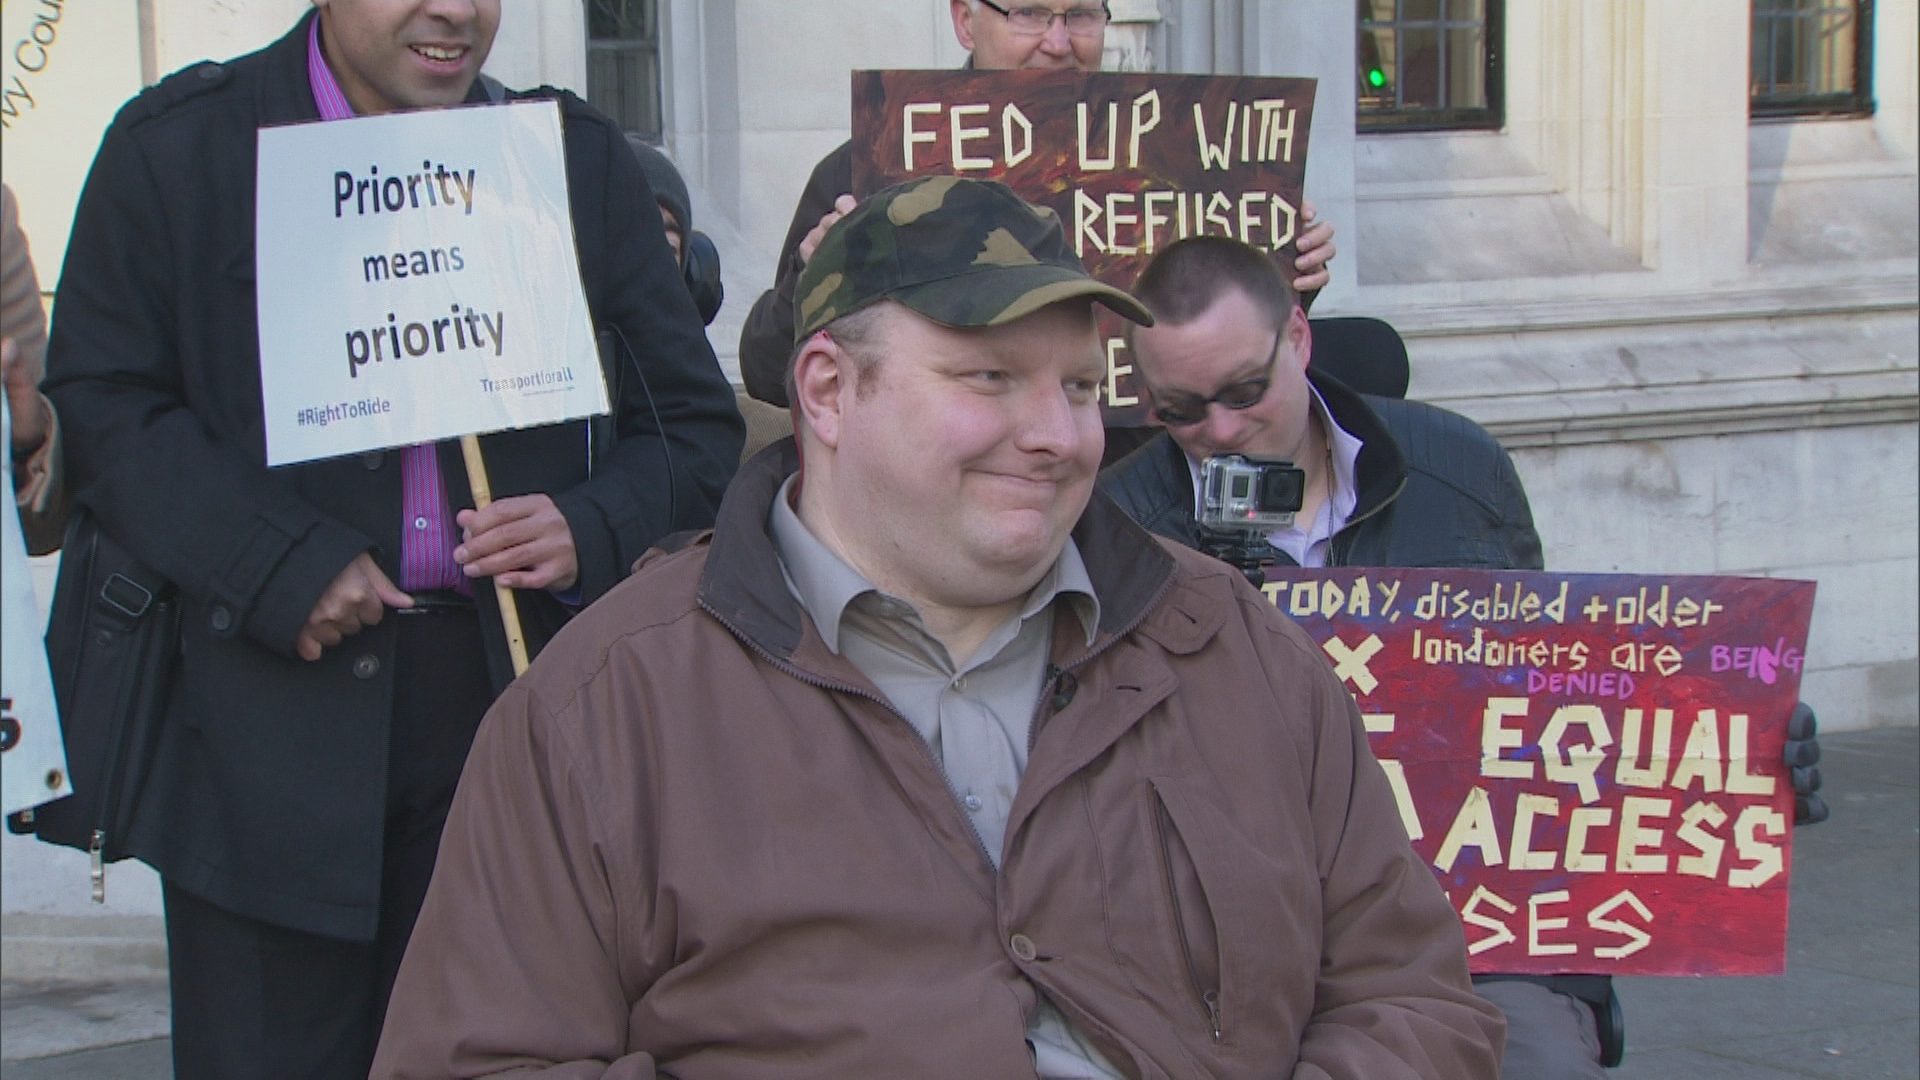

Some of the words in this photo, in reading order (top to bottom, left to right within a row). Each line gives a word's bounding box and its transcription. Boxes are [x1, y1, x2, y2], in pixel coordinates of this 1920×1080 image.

[903, 102, 1033, 171] FED
[1076, 89, 1161, 171] UP
[1193, 98, 1297, 171] WITH
[334, 160, 475, 218] Priority
[1074, 188, 1297, 258] REFUSED
[363, 246, 465, 282] means
[345, 304, 503, 378] priority
[297, 397, 391, 426] #RightToRide
[1413, 581, 1568, 625] disabled
[1615, 585, 1723, 628] older
[1412, 627, 1589, 671] londoners
[1611, 643, 1683, 677] are
[1711, 637, 1806, 684] BEING
[1527, 669, 1635, 700] DENIED
[1480, 697, 1776, 804] EQUAL
[1433, 785, 1786, 889] ACCESS
[1445, 885, 1654, 960] SES
